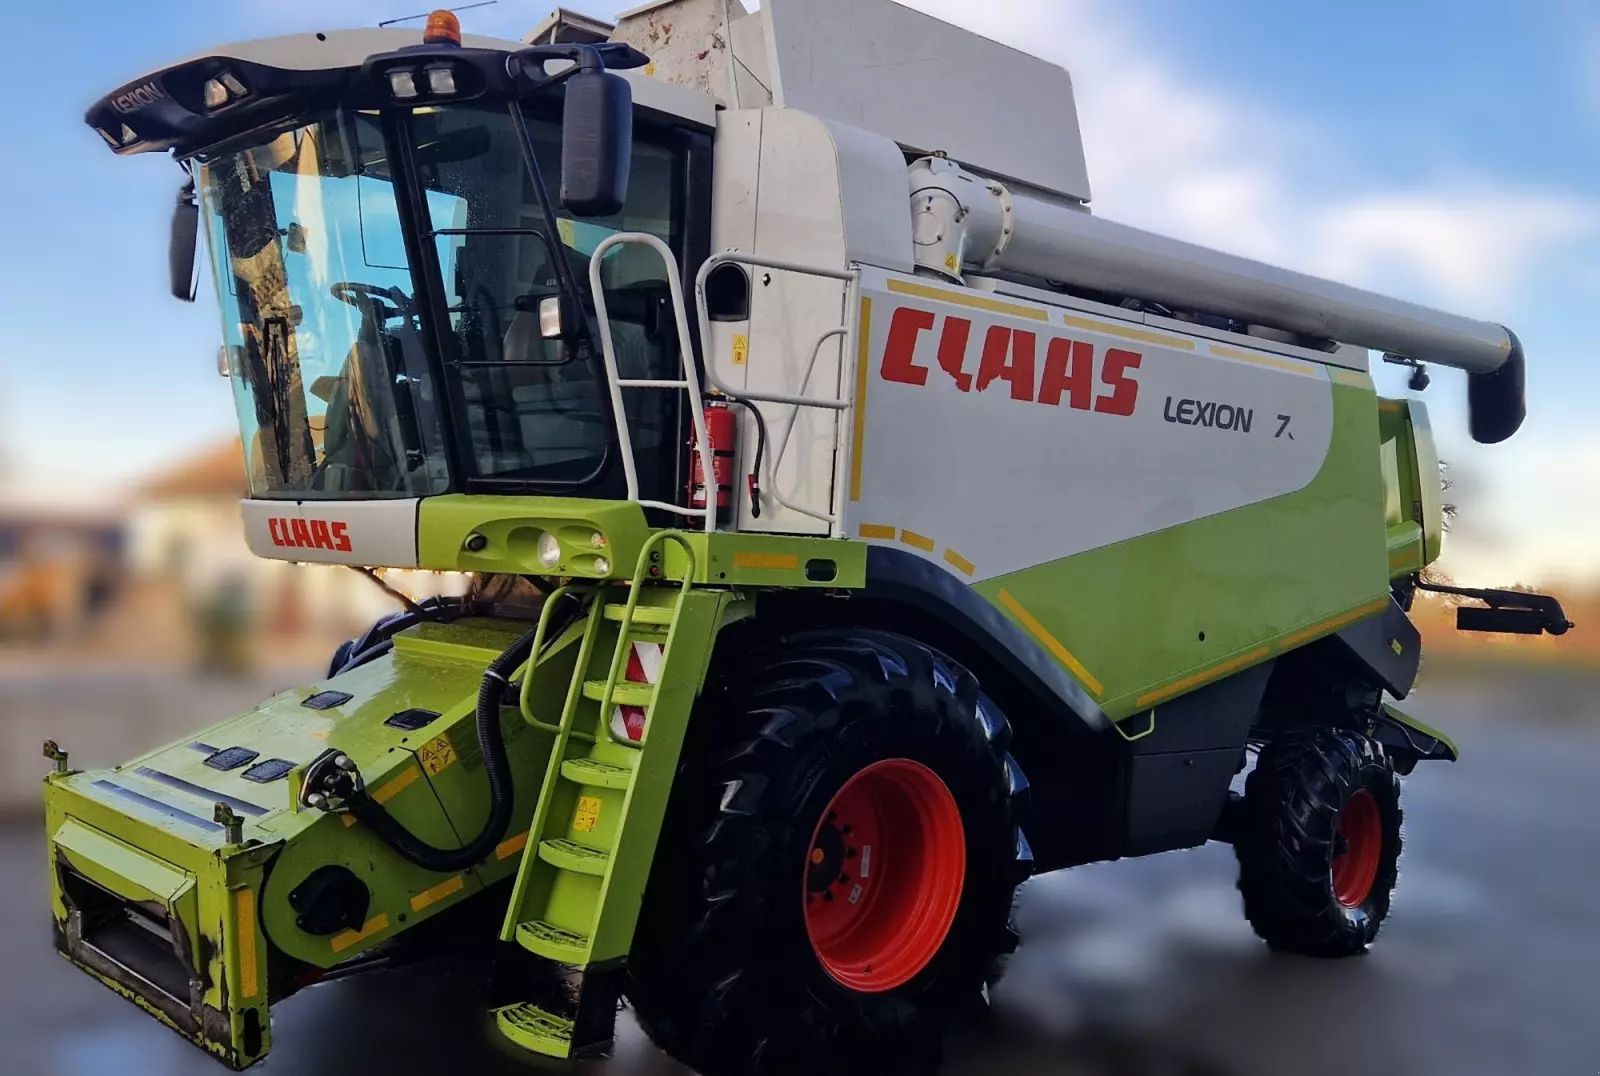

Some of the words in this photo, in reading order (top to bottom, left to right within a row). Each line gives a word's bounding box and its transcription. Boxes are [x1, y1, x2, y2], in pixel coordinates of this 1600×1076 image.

[111, 82, 165, 113] LEXION
[880, 306, 1143, 417] CLAAS
[1163, 396, 1254, 433] LEXION
[268, 517, 352, 552] CLAAS
